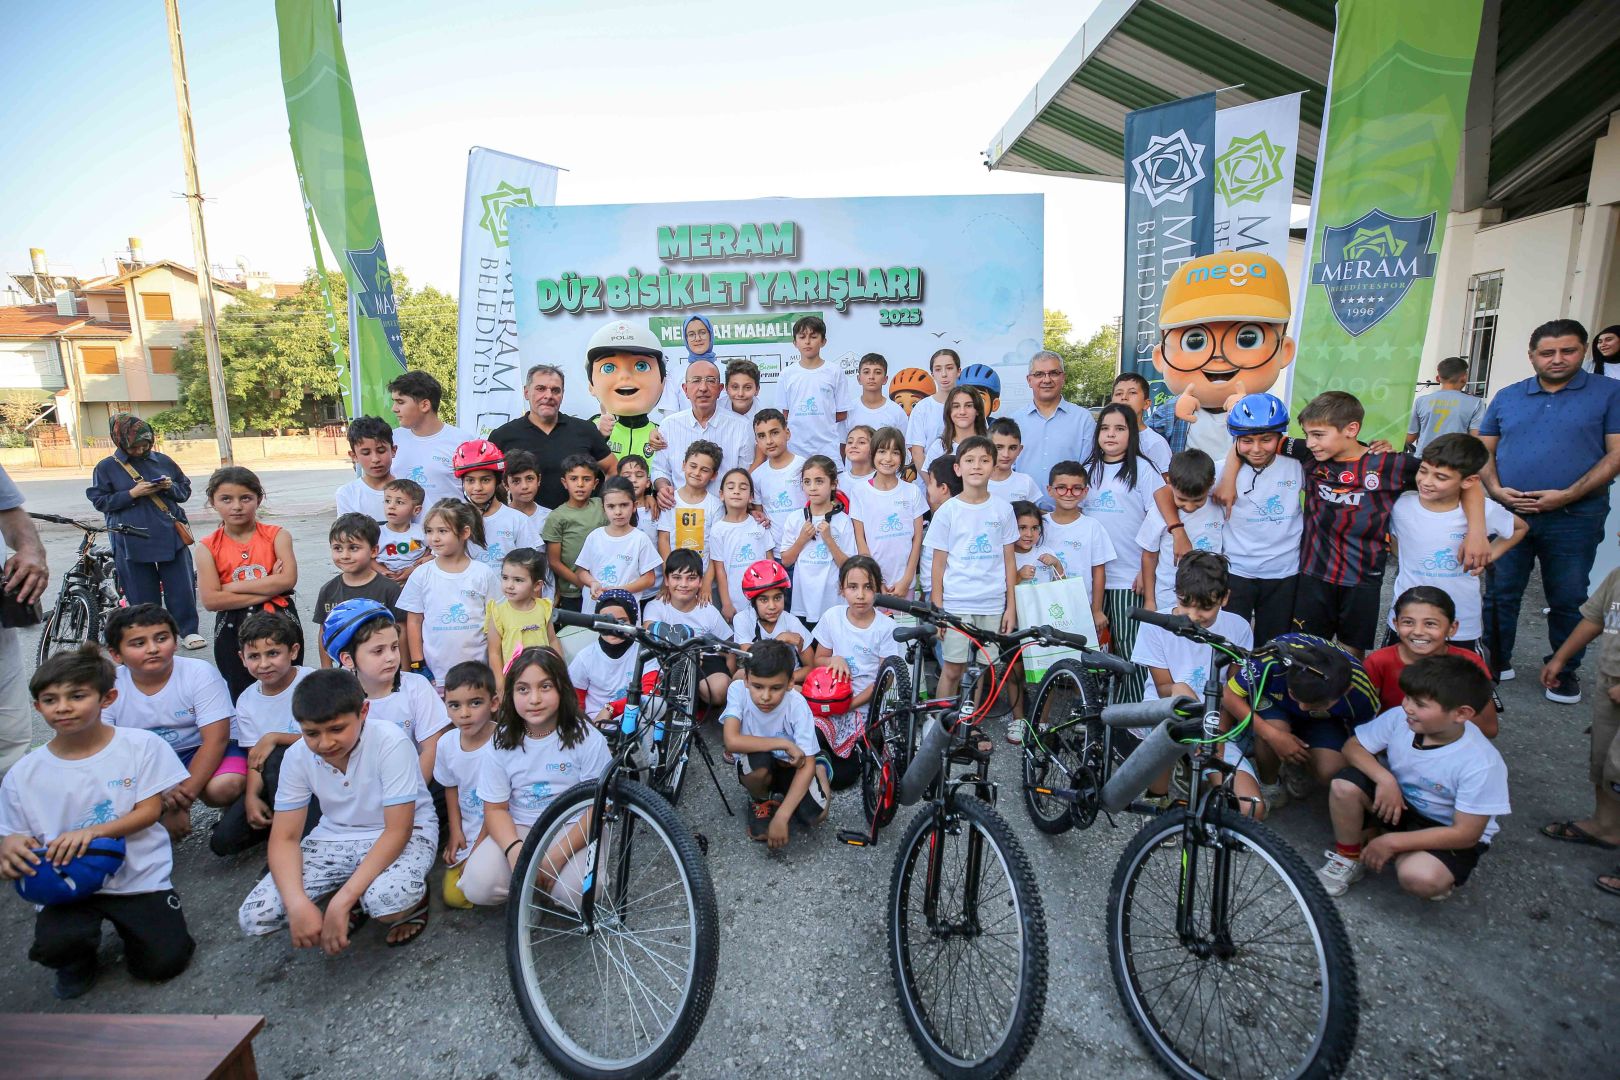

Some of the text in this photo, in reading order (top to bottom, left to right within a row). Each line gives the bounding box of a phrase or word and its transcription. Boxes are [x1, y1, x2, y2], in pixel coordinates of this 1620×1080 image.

[657, 221, 796, 262] MERAM
[1186, 263, 1266, 286] mega
[1321, 257, 1419, 281] MERAM
[537, 266, 922, 313] DÜZ BİSİKLET YARIŞLARI
[879, 308, 922, 326] 2025
[1346, 307, 1374, 318] 1996
[735, 321, 794, 338] MAHALL
[1433, 408, 1450, 432] 7
[1318, 484, 1365, 506] SIXT
[681, 512, 697, 526] 61
[546, 761, 572, 771] mega
